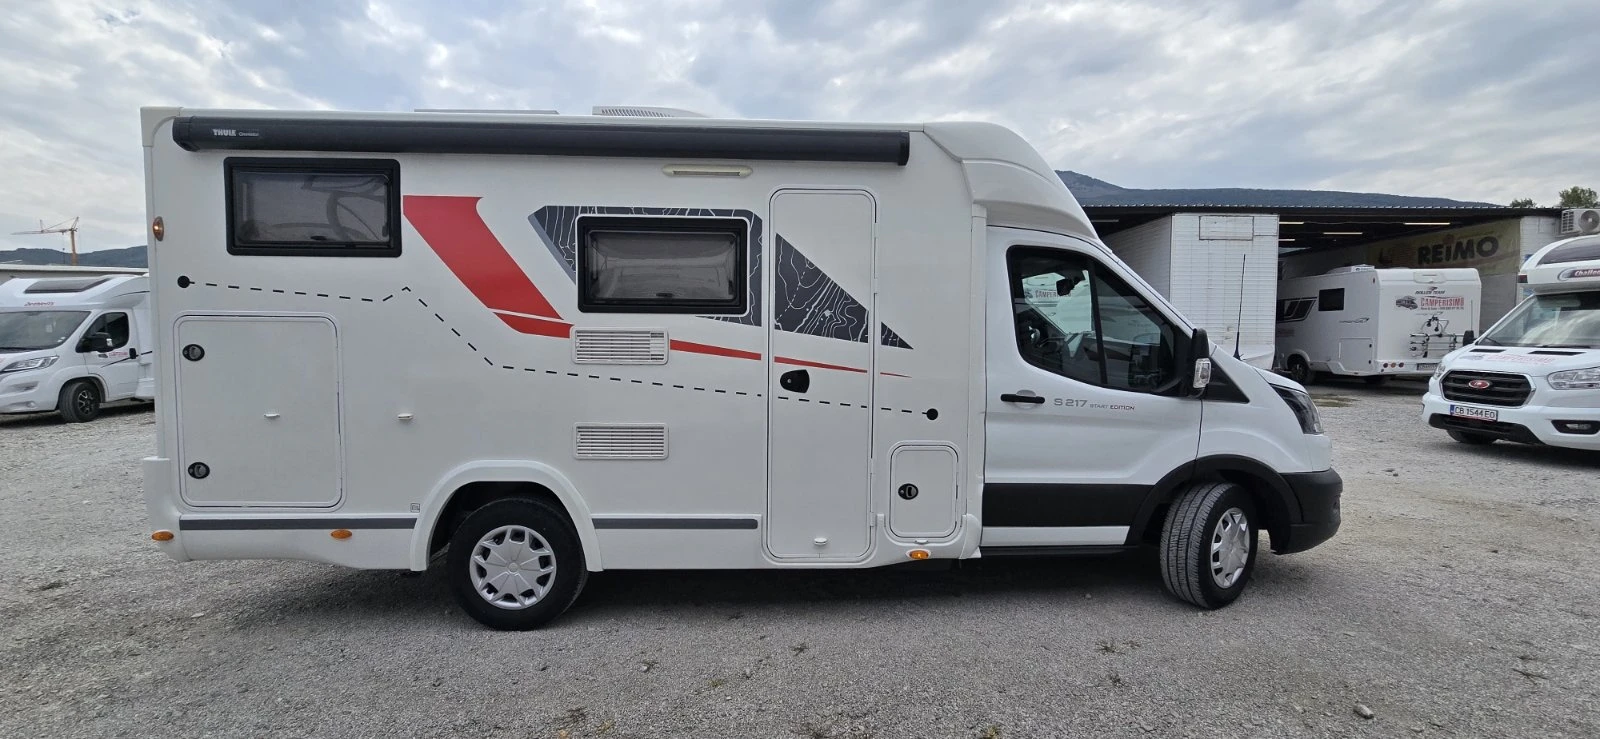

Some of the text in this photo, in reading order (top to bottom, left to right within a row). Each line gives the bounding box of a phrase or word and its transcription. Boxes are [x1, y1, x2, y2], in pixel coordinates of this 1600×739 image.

[212, 128, 237, 136] THULE
[1420, 296, 1465, 307] CAMPERISIMO
[1054, 398, 1063, 406] S
[1065, 398, 1088, 408] 217
[1455, 406, 1496, 419] CB 1544 EO
